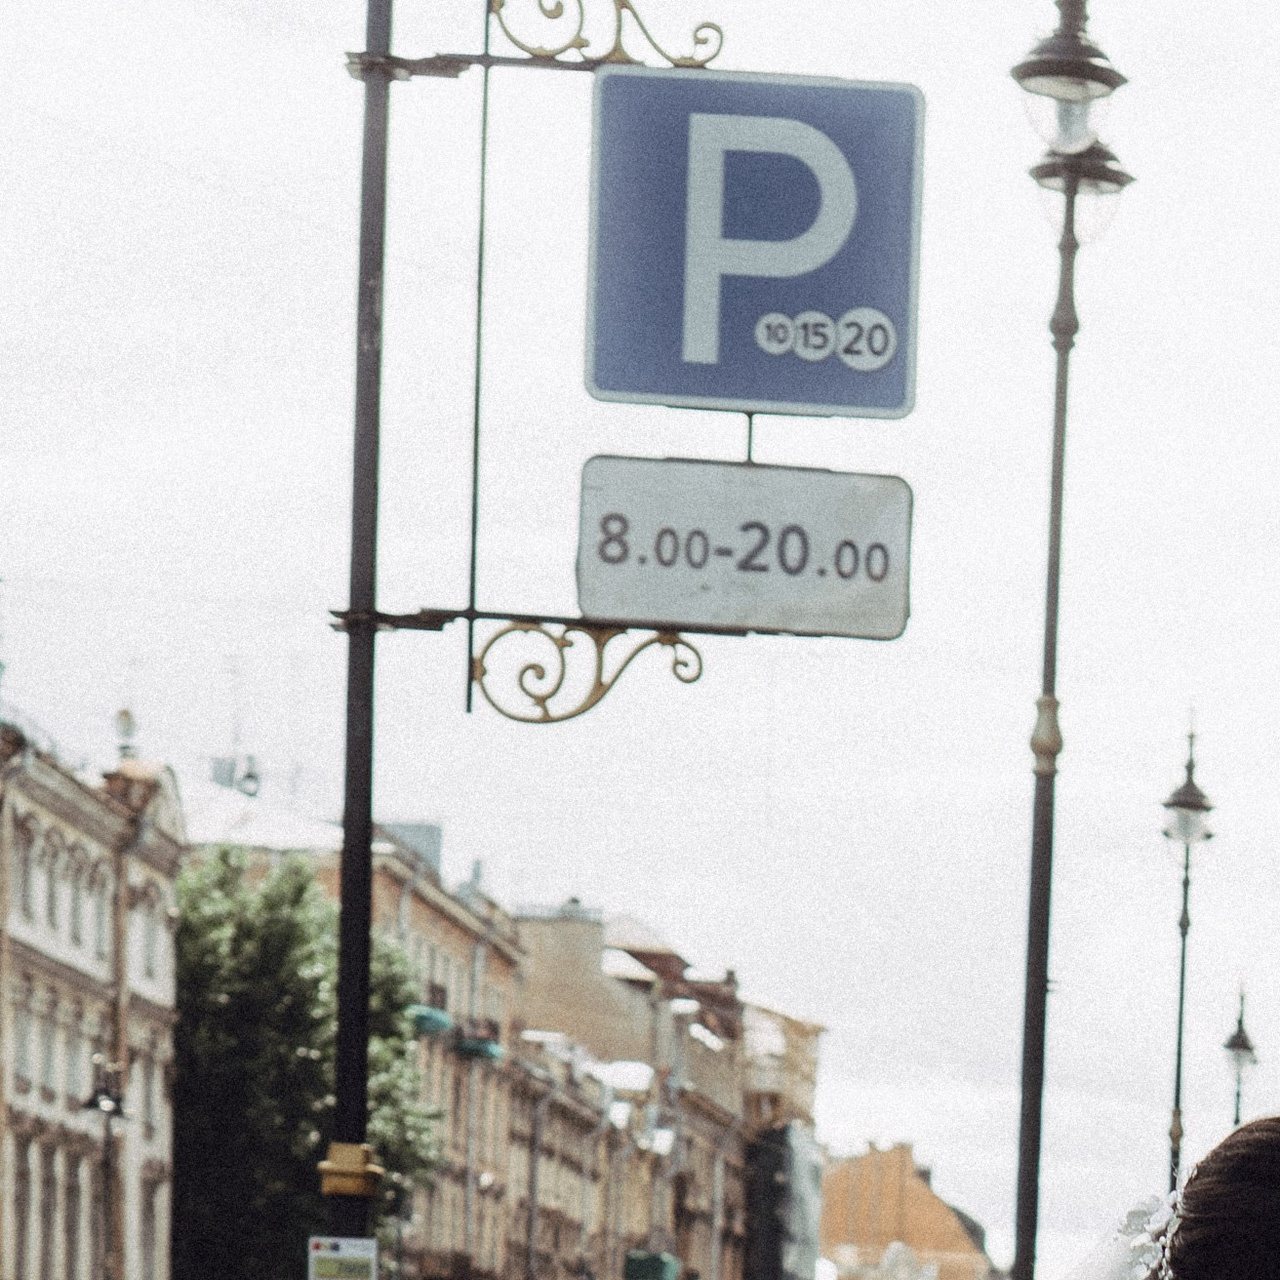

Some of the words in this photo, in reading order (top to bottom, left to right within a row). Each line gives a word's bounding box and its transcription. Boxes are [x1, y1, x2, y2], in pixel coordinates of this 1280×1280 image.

[683, 112, 859, 364] P
[764, 322, 790, 344] 10
[801, 322, 829, 350] 15
[842, 321, 890, 356] 20
[599, 512, 890, 582] 8.00-20.00
